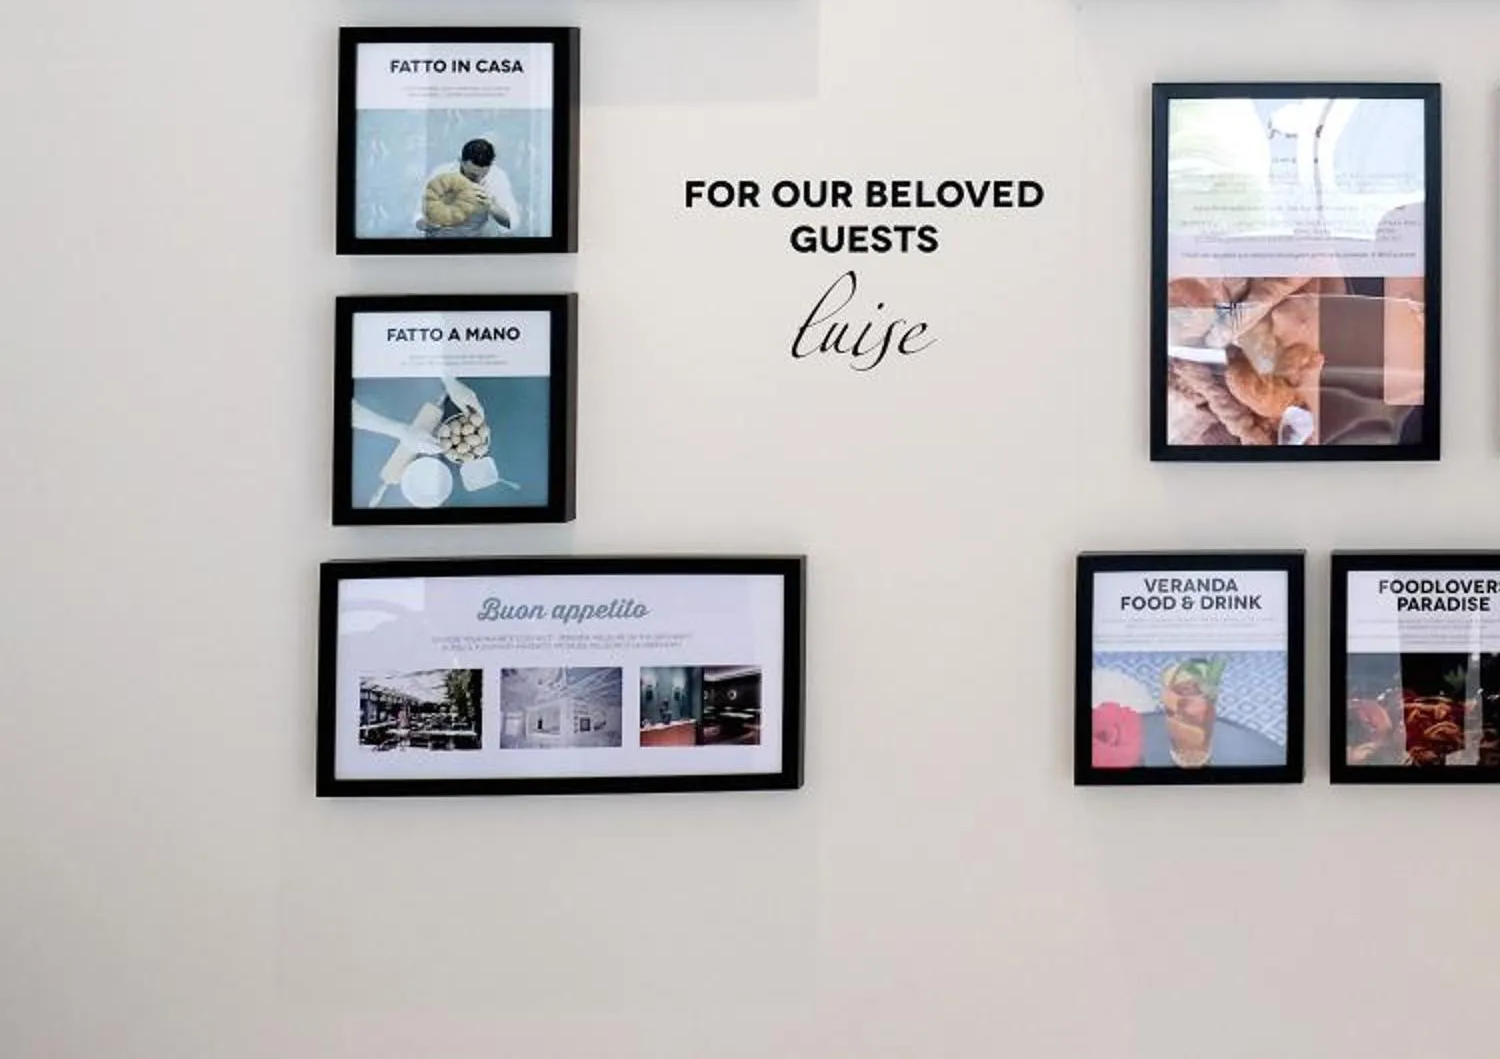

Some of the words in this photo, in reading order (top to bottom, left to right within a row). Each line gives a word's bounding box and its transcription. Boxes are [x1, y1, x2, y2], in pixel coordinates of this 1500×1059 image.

[389, 58, 448, 74] FATTO
[451, 59, 471, 74] IN
[475, 58, 524, 74] CASA
[685, 180, 761, 208] FOR
[771, 180, 853, 208] OUR
[865, 180, 1045, 209] BELOVED
[789, 224, 939, 254] GUESTS
[387, 327, 444, 342] FATTO
[447, 327, 461, 342] A
[465, 326, 521, 342] MANO
[1143, 577, 1239, 594] VERANDA
[476, 596, 548, 622] Buon
[551, 598, 651, 625] appetito
[1120, 595, 1177, 612] FOOD
[1181, 595, 1195, 611] &
[1200, 594, 1263, 611] DRINK
[1397, 596, 1491, 612] PARADISE
